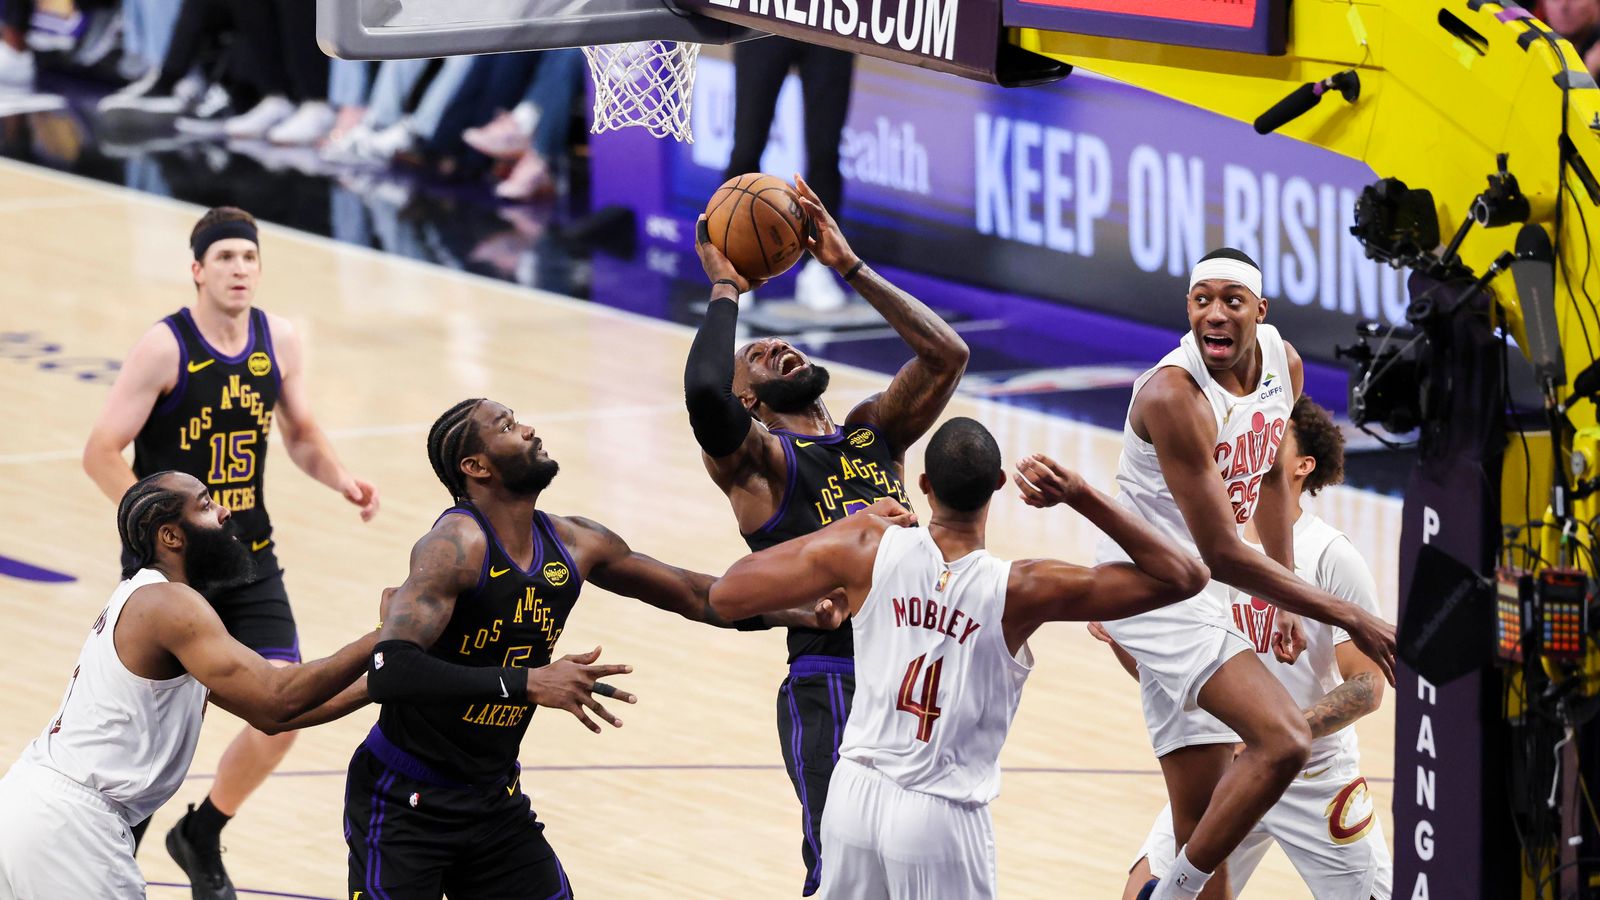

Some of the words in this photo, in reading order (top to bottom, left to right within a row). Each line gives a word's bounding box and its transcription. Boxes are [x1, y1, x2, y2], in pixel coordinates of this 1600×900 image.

[709, 0, 959, 60] S.COM
[838, 116, 929, 195] ealth
[974, 112, 1112, 257] KEEP
[1128, 144, 1206, 277] ON
[180, 407, 212, 450] LOS
[221, 375, 272, 440] ANGELE
[1260, 385, 1283, 400] CLIFFS
[208, 430, 257, 484] 15
[1213, 417, 1285, 480] CAVS
[213, 486, 256, 512] AKERS
[815, 475, 844, 525] LOS
[459, 620, 503, 655] LOS
[513, 587, 562, 658] ANGELE
[892, 597, 981, 645] MOBLEY
[462, 703, 528, 727] LAKERS
[896, 652, 944, 743] 4
